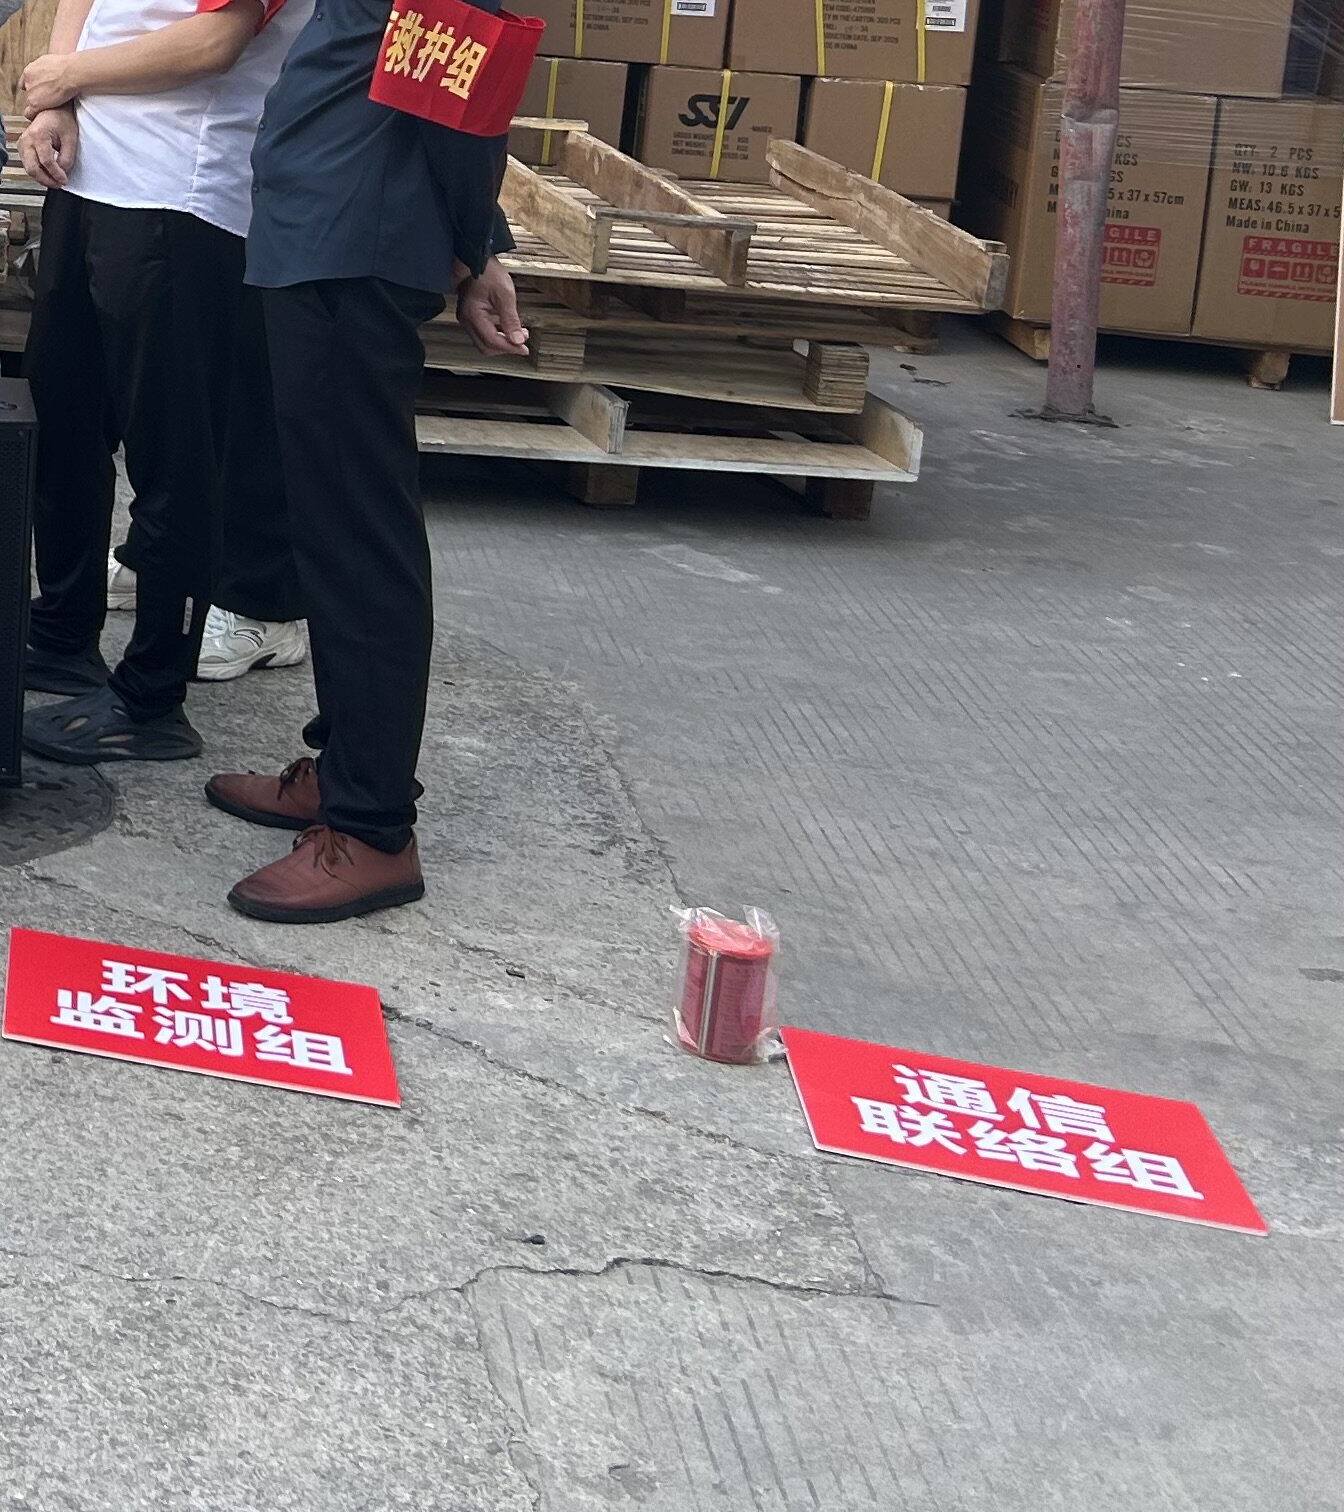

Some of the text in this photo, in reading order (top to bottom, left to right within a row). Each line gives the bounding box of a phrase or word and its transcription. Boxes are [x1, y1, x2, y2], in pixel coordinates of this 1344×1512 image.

[1117, 135, 1132, 148] CS
[1115, 153, 1138, 166] KGS
[1270, 146, 1278, 158] 2
[1289, 147, 1313, 161] PCS
[1109, 170, 1124, 183] GS
[1295, 166, 1319, 179] KGS
[1260, 181, 1272, 194] 13
[1280, 183, 1304, 196] KGS
[1127, 190, 1141, 201] 37
[1153, 192, 1184, 205] 57cm
[1307, 204, 1321, 217] 37
[1226, 215, 1309, 233] Made in China
[1109, 227, 1157, 240] GILE
[101, 959, 294, 1024] 环境
[50, 989, 353, 1076] 监测组
[891, 1063, 1115, 1143] 通信
[850, 1096, 1205, 1201] 联络组
